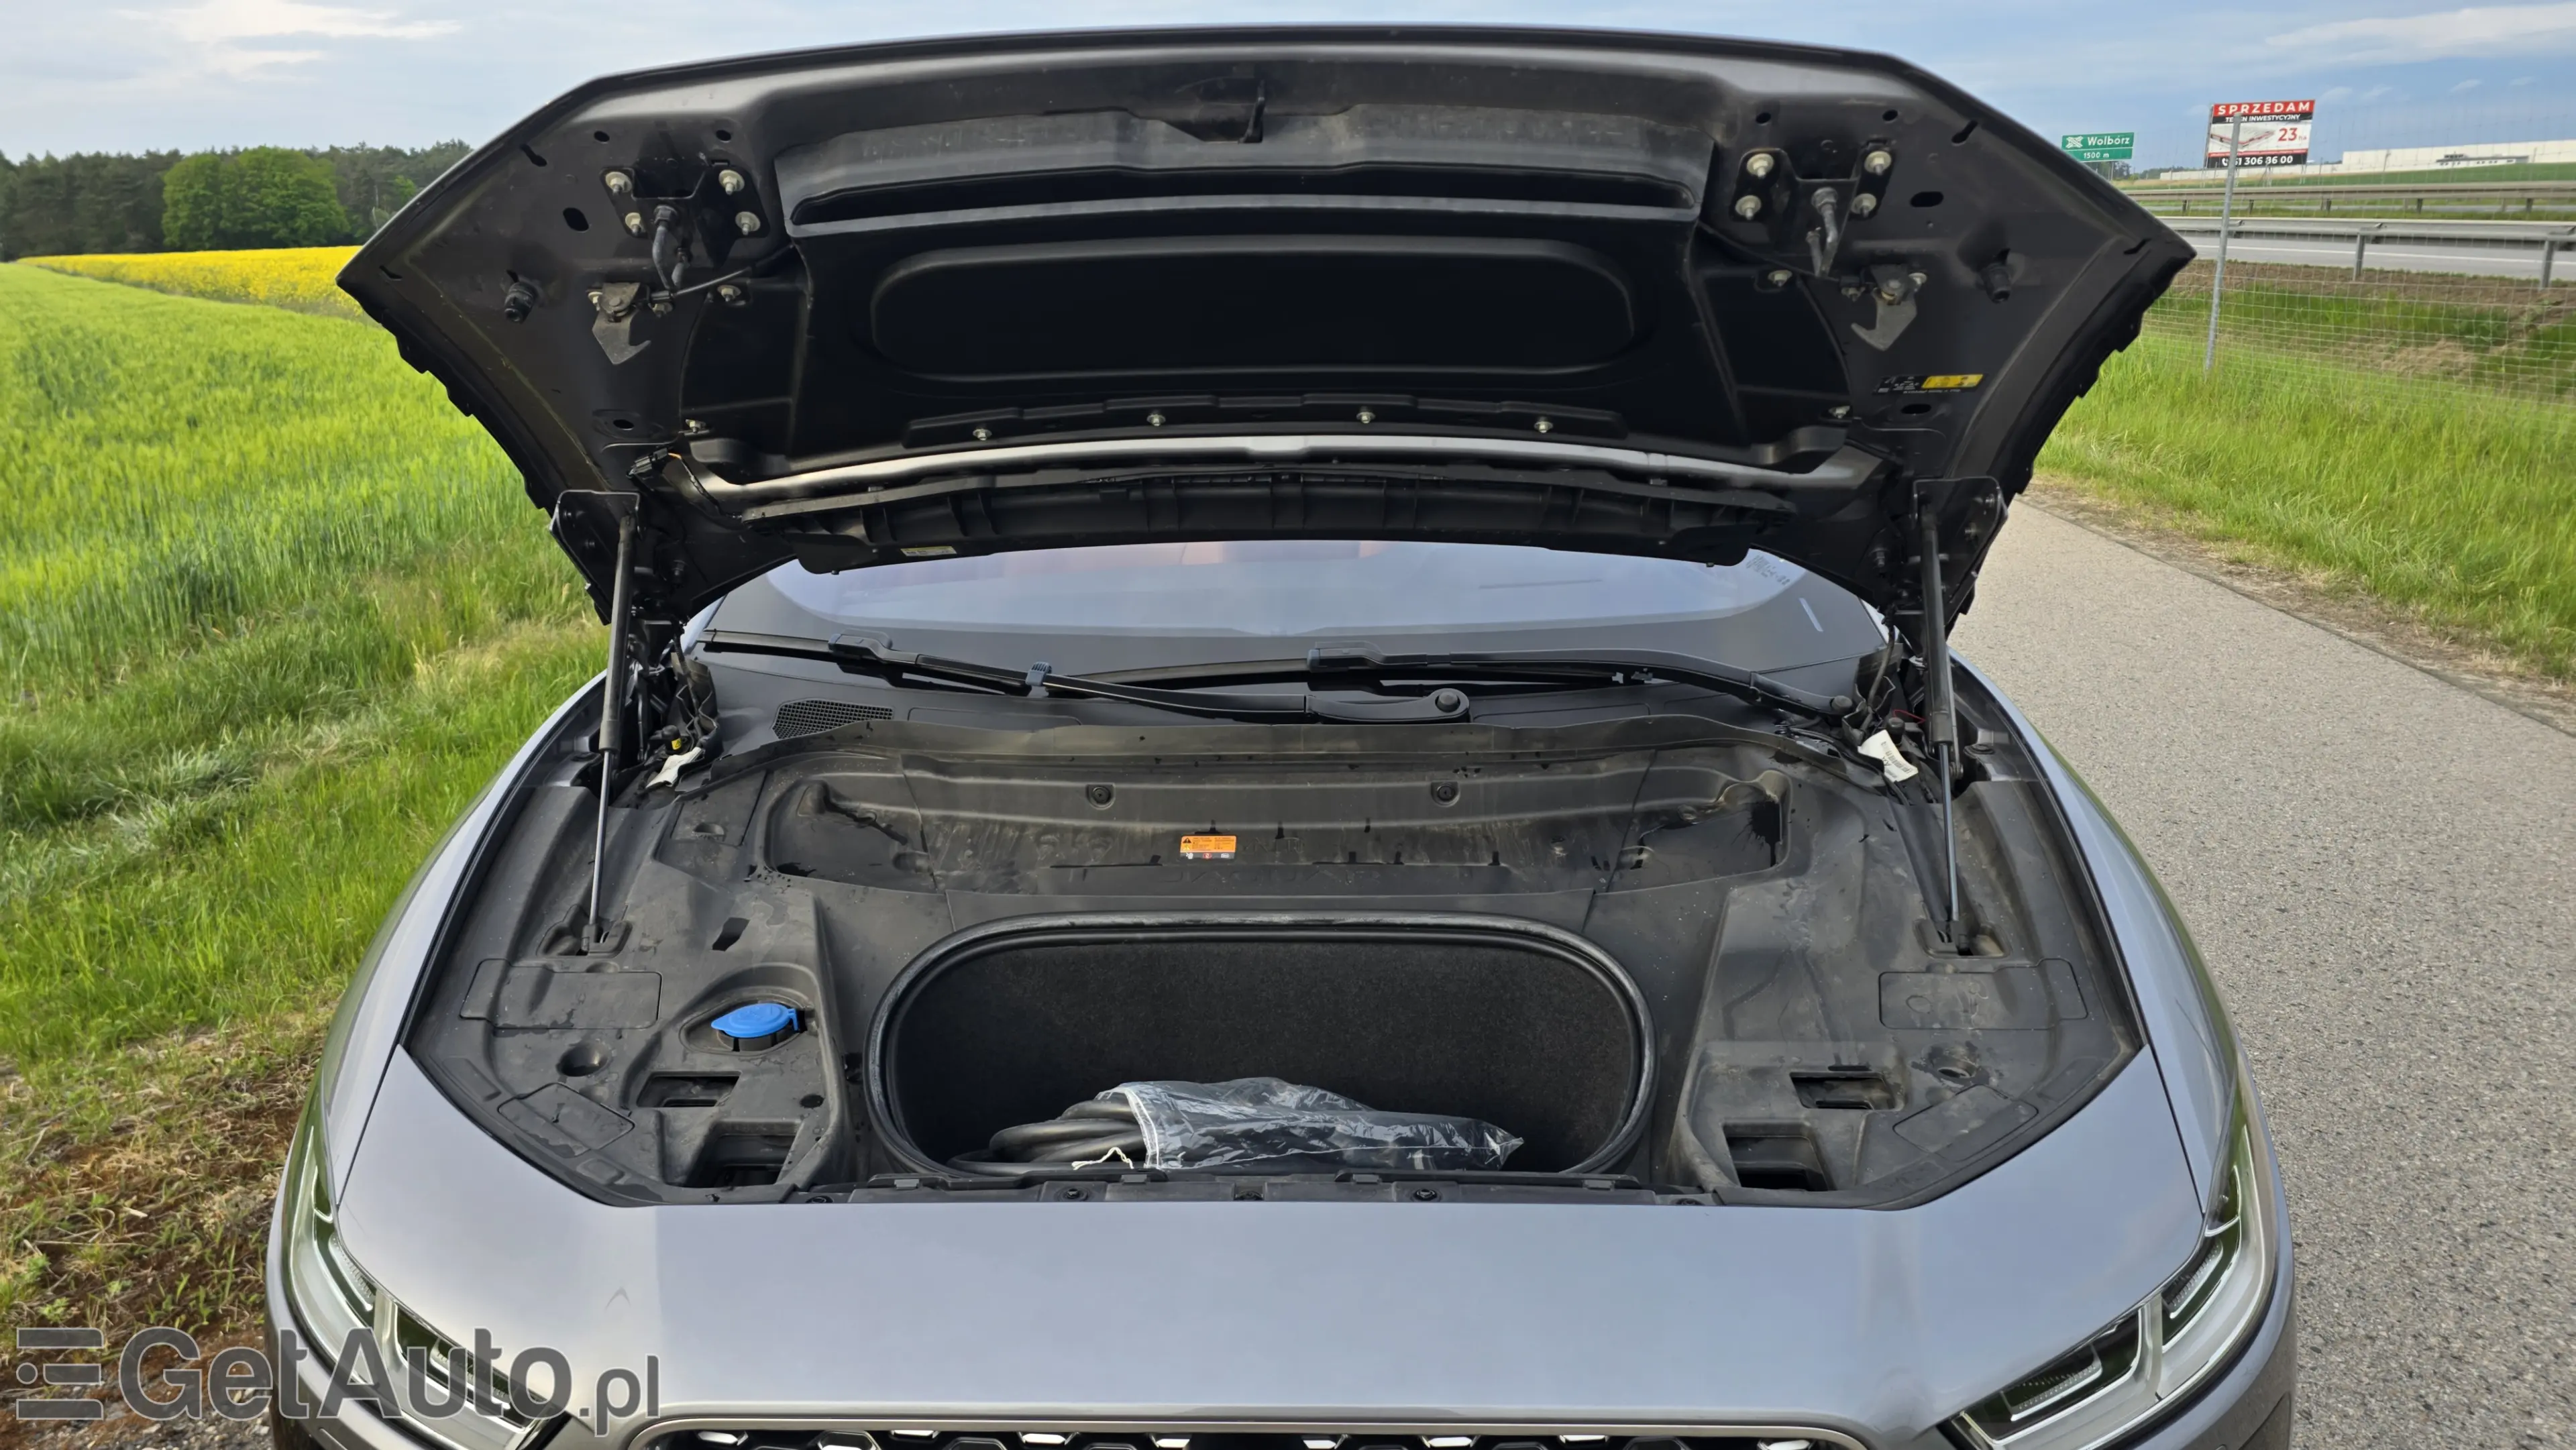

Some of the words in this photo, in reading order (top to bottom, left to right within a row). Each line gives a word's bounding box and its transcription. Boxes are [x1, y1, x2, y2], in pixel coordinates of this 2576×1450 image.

[2218, 102, 2310, 115] SPRZEDAM
[2087, 135, 2130, 146] Wolbórz
[2278, 127, 2298, 142] 23
